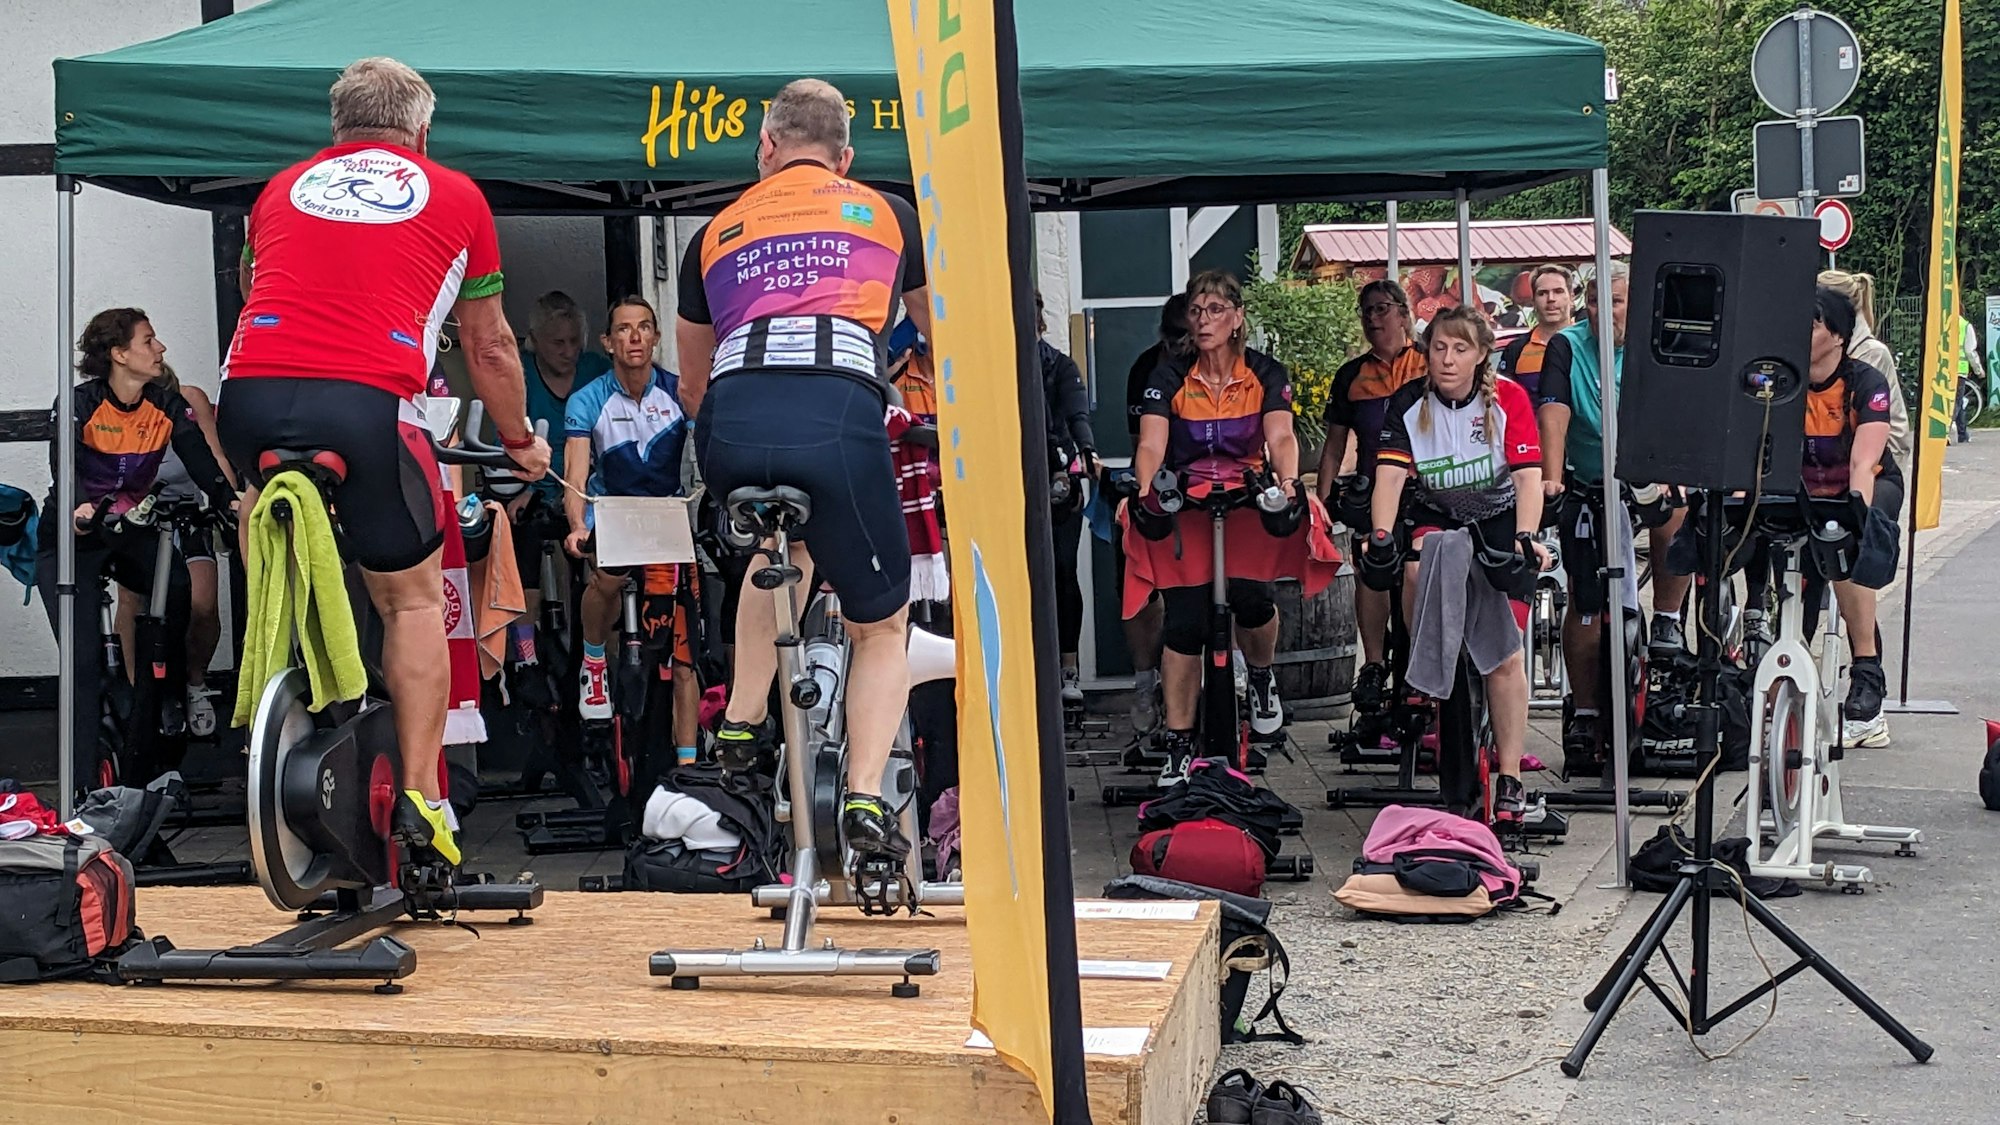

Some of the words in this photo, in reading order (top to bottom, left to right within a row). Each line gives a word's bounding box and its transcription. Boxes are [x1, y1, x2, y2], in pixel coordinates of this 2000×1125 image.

[641, 80, 747, 168] Hits
[302, 199, 327, 213] April
[327, 207, 360, 218] 2012
[736, 237, 851, 268] Spinning
[737, 253, 849, 284] Marathon
[763, 270, 819, 291] 2025
